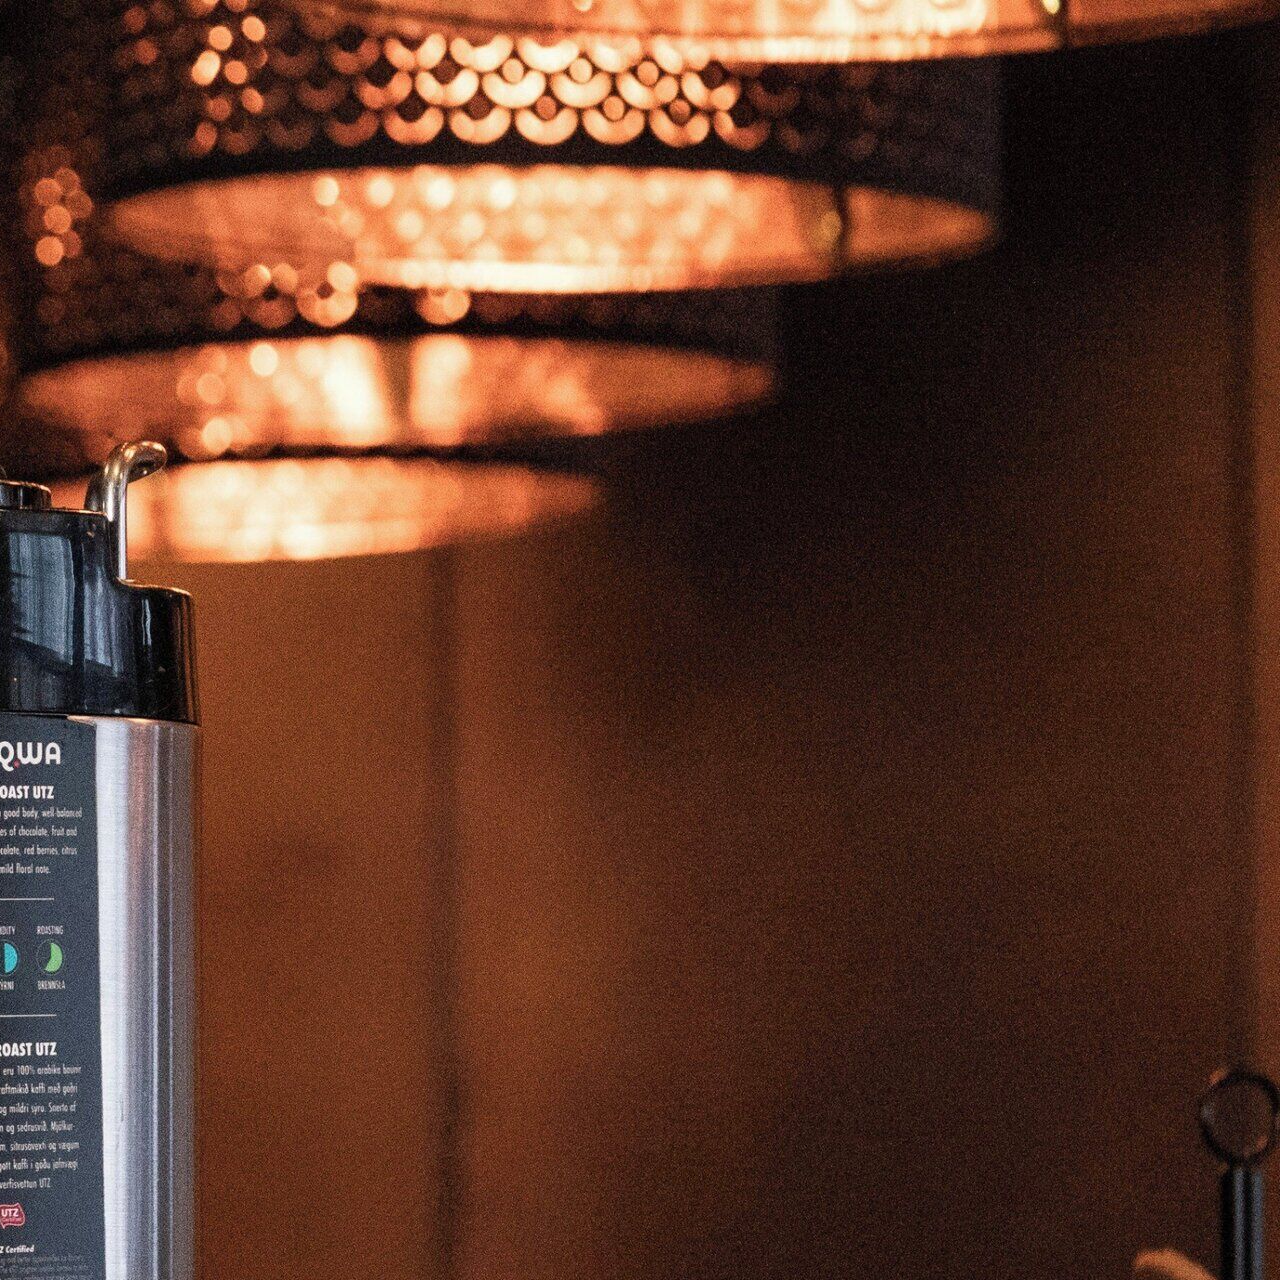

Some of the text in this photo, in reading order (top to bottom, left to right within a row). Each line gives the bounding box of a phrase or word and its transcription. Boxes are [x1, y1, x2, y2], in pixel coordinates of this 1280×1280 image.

[33, 786, 54, 799] UTZ
[4, 807, 20, 819] good
[42, 807, 82, 818] well-balanced
[9, 826, 16, 836] of
[52, 826, 64, 835] fruit
[66, 826, 77, 835] and
[24, 845, 34, 855] red
[62, 845, 77, 855] citrus
[0, 864, 13, 874] mild
[16, 864, 33, 873] floral
[35, 864, 51, 873] note.
[37, 926, 63, 935] ROASTING
[35, 1042, 57, 1056] UTZ
[3, 1068, 14, 1076] eru
[38, 1065, 60, 1075] arabika
[48, 1083, 60, 1093] með
[9, 1102, 28, 1113] mildri
[6, 1124, 14, 1134] og
[49, 1142, 56, 1152] og
[40, 1178, 50, 1188] UTZ
[1, 1208, 18, 1217] UTZ
[5, 1244, 35, 1253] Certified
